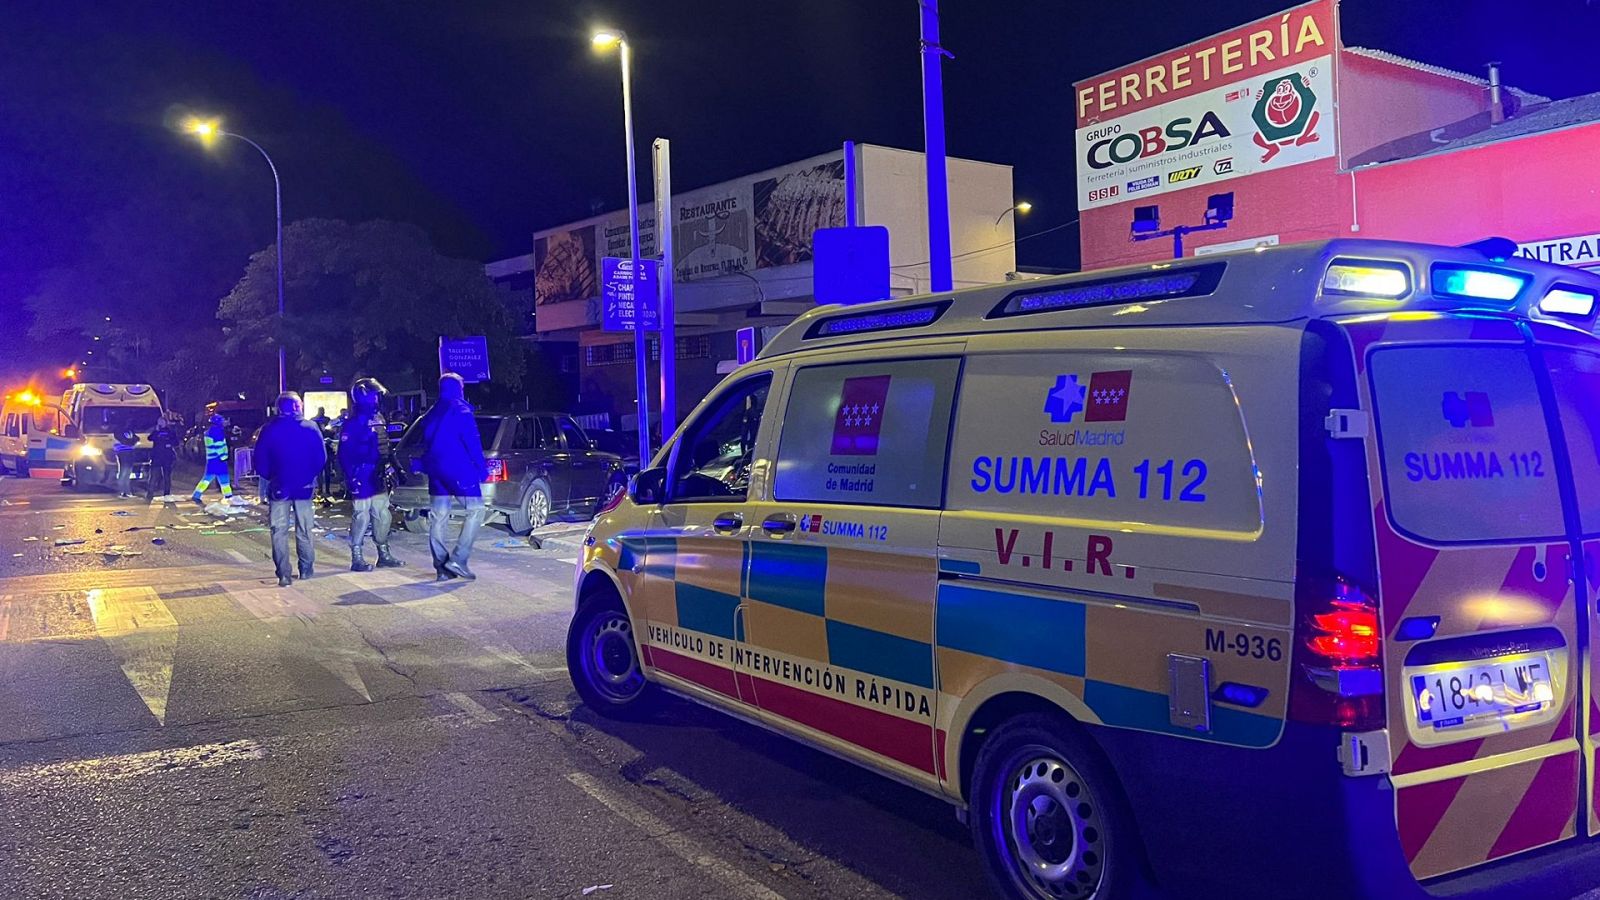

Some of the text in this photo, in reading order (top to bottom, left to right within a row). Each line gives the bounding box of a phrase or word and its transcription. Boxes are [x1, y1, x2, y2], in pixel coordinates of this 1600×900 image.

[1079, 14, 1324, 118] FERRETERÍA
[1087, 125, 1121, 141] GRUPO
[1087, 111, 1231, 169] COBSA
[1088, 143, 1233, 183] ferretería suministros industriales
[1523, 239, 1600, 263] NTRA
[618, 292, 635, 300] PINTU
[1039, 429, 1125, 446] SaludMadrid
[828, 463, 876, 475] Comunidad
[971, 456, 1208, 502] SUMMA 112
[1405, 451, 1545, 482] SUMMA 112
[826, 478, 874, 492] de Madrid
[822, 520, 864, 538] SUMMA
[868, 525, 888, 541] 112
[995, 528, 1136, 579] V.I.R.
[1205, 628, 1282, 662] M-936
[649, 625, 931, 717] VEHÍCULO DE INTERVENCIÓN RÁPIDA
